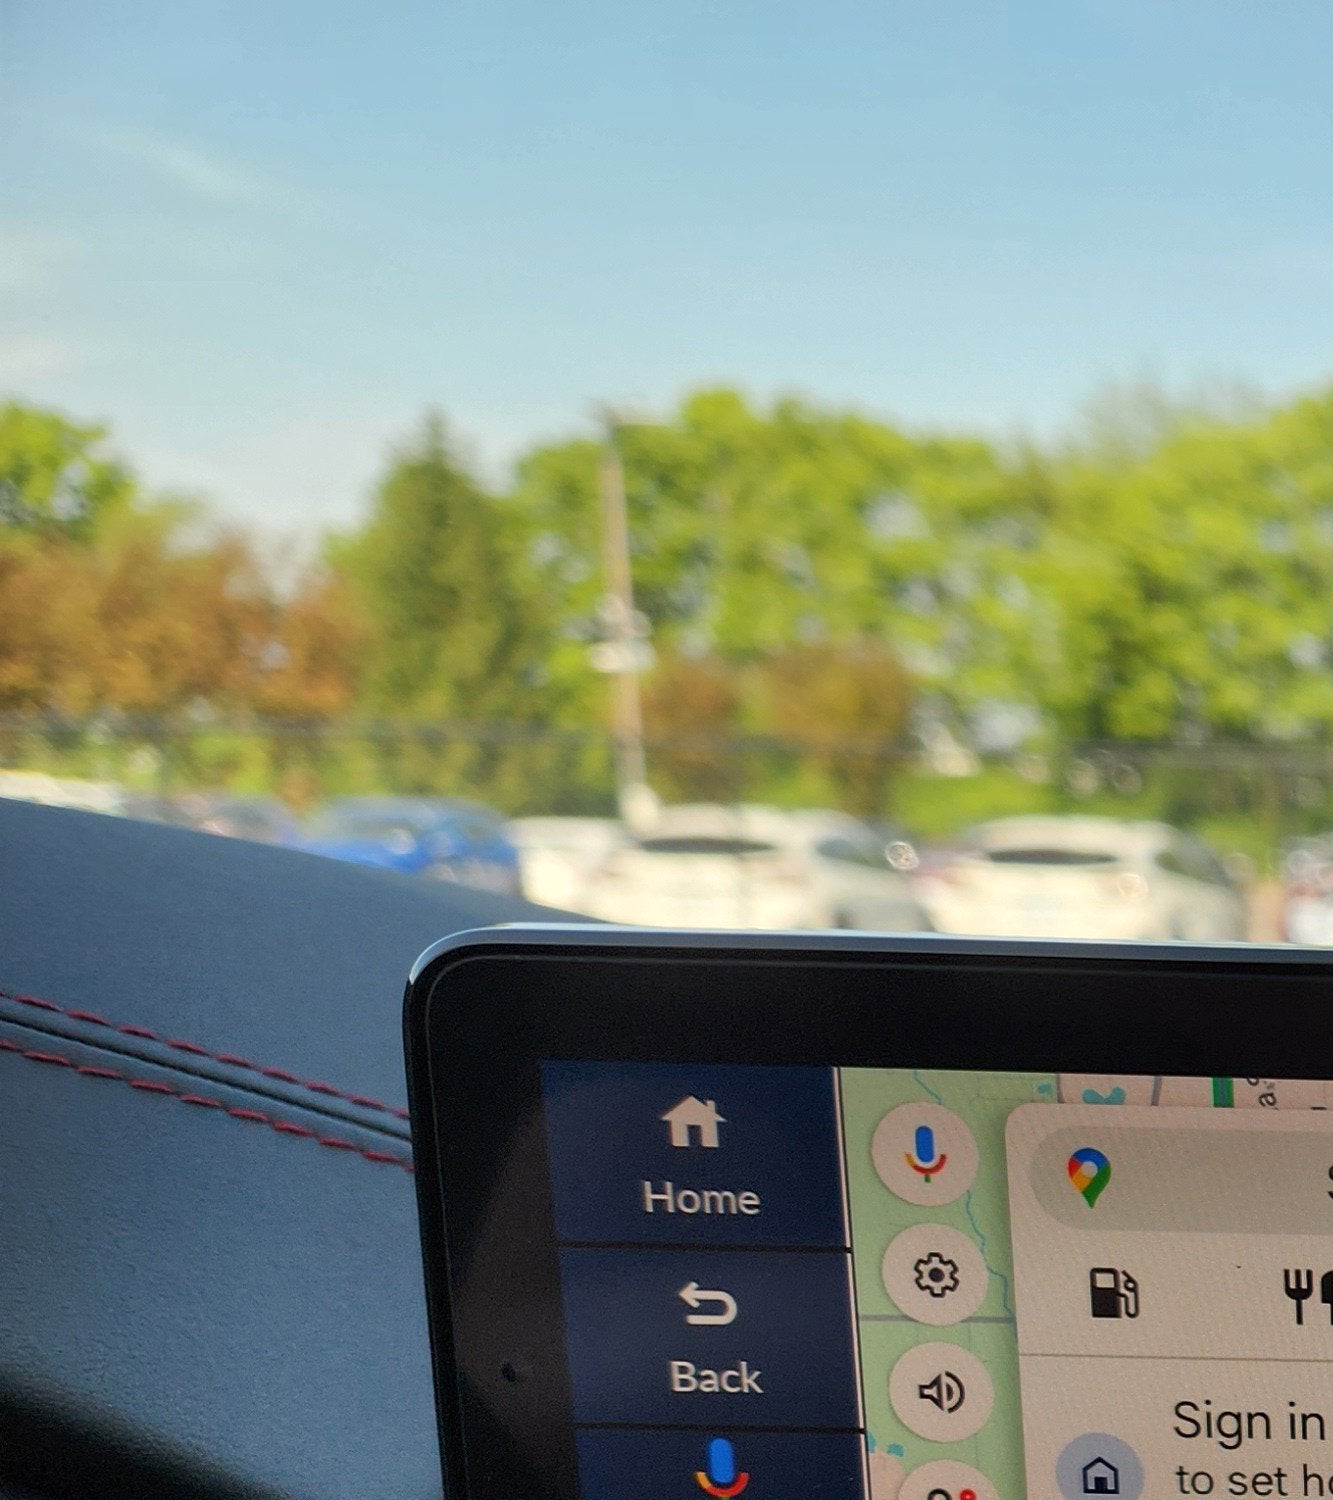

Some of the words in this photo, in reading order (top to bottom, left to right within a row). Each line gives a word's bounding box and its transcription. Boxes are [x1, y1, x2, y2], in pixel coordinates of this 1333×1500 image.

[641, 1180, 761, 1216] Home
[669, 1361, 764, 1394] Back
[1173, 1400, 1272, 1450] Sign
[1288, 1402, 1327, 1442] in
[1175, 1465, 1215, 1497] to
[1228, 1468, 1289, 1499] set
